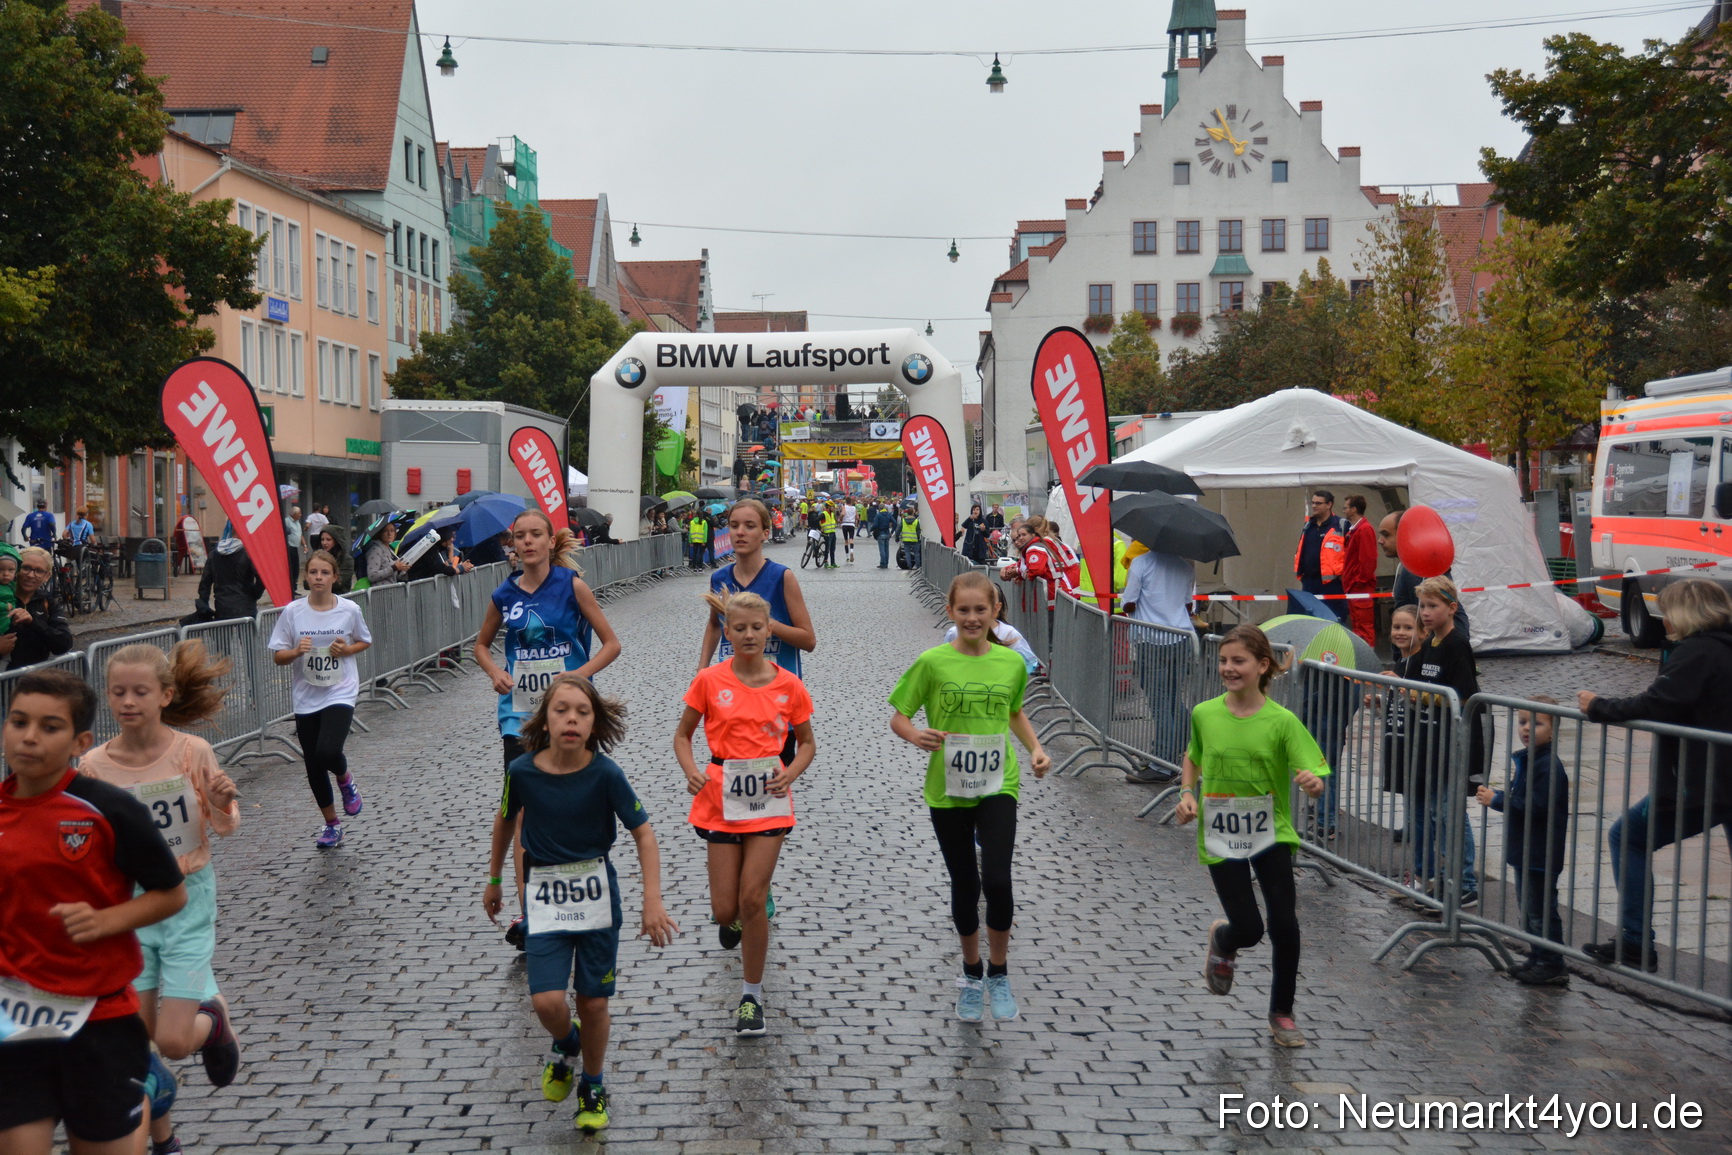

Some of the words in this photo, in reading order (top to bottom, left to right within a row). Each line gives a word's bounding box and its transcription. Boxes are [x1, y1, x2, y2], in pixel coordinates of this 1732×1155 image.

[656, 343, 739, 368] BMW
[746, 342, 891, 372] Laufsport
[828, 445, 856, 456] ZIEL
[307, 656, 339, 672] 4026
[517, 672, 561, 693] 400
[951, 750, 1000, 774] 4013
[730, 772, 776, 797] 401
[960, 778, 987, 789] Victoria
[152, 795, 189, 829] 31
[749, 802, 766, 811] Mia
[1211, 811, 1268, 834] 4012
[168, 836, 182, 847] sa
[1228, 840, 1253, 849] Luisa
[535, 875, 602, 905] 4050
[555, 912, 586, 921] Jonas
